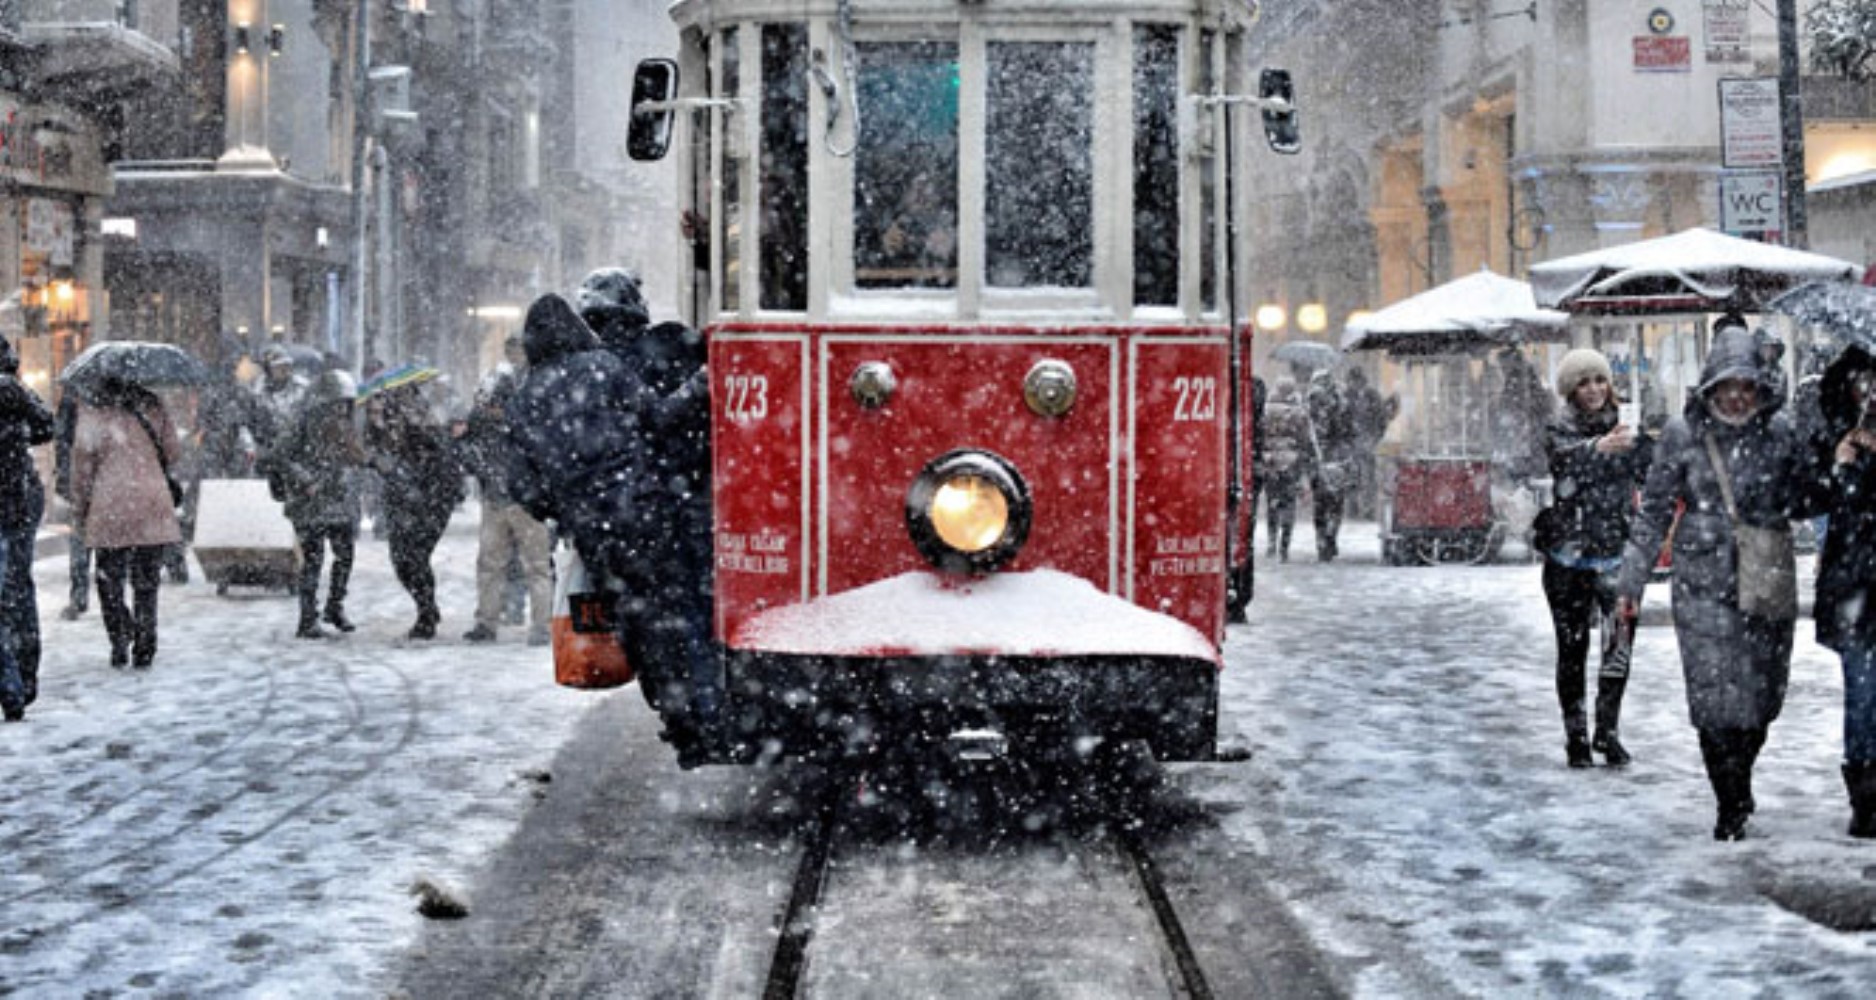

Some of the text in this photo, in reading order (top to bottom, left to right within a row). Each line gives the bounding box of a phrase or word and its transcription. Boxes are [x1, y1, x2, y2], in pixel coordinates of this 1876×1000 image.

[1730, 191, 1773, 213] WC
[725, 375, 768, 420] 223
[1174, 376, 1215, 421] 223
